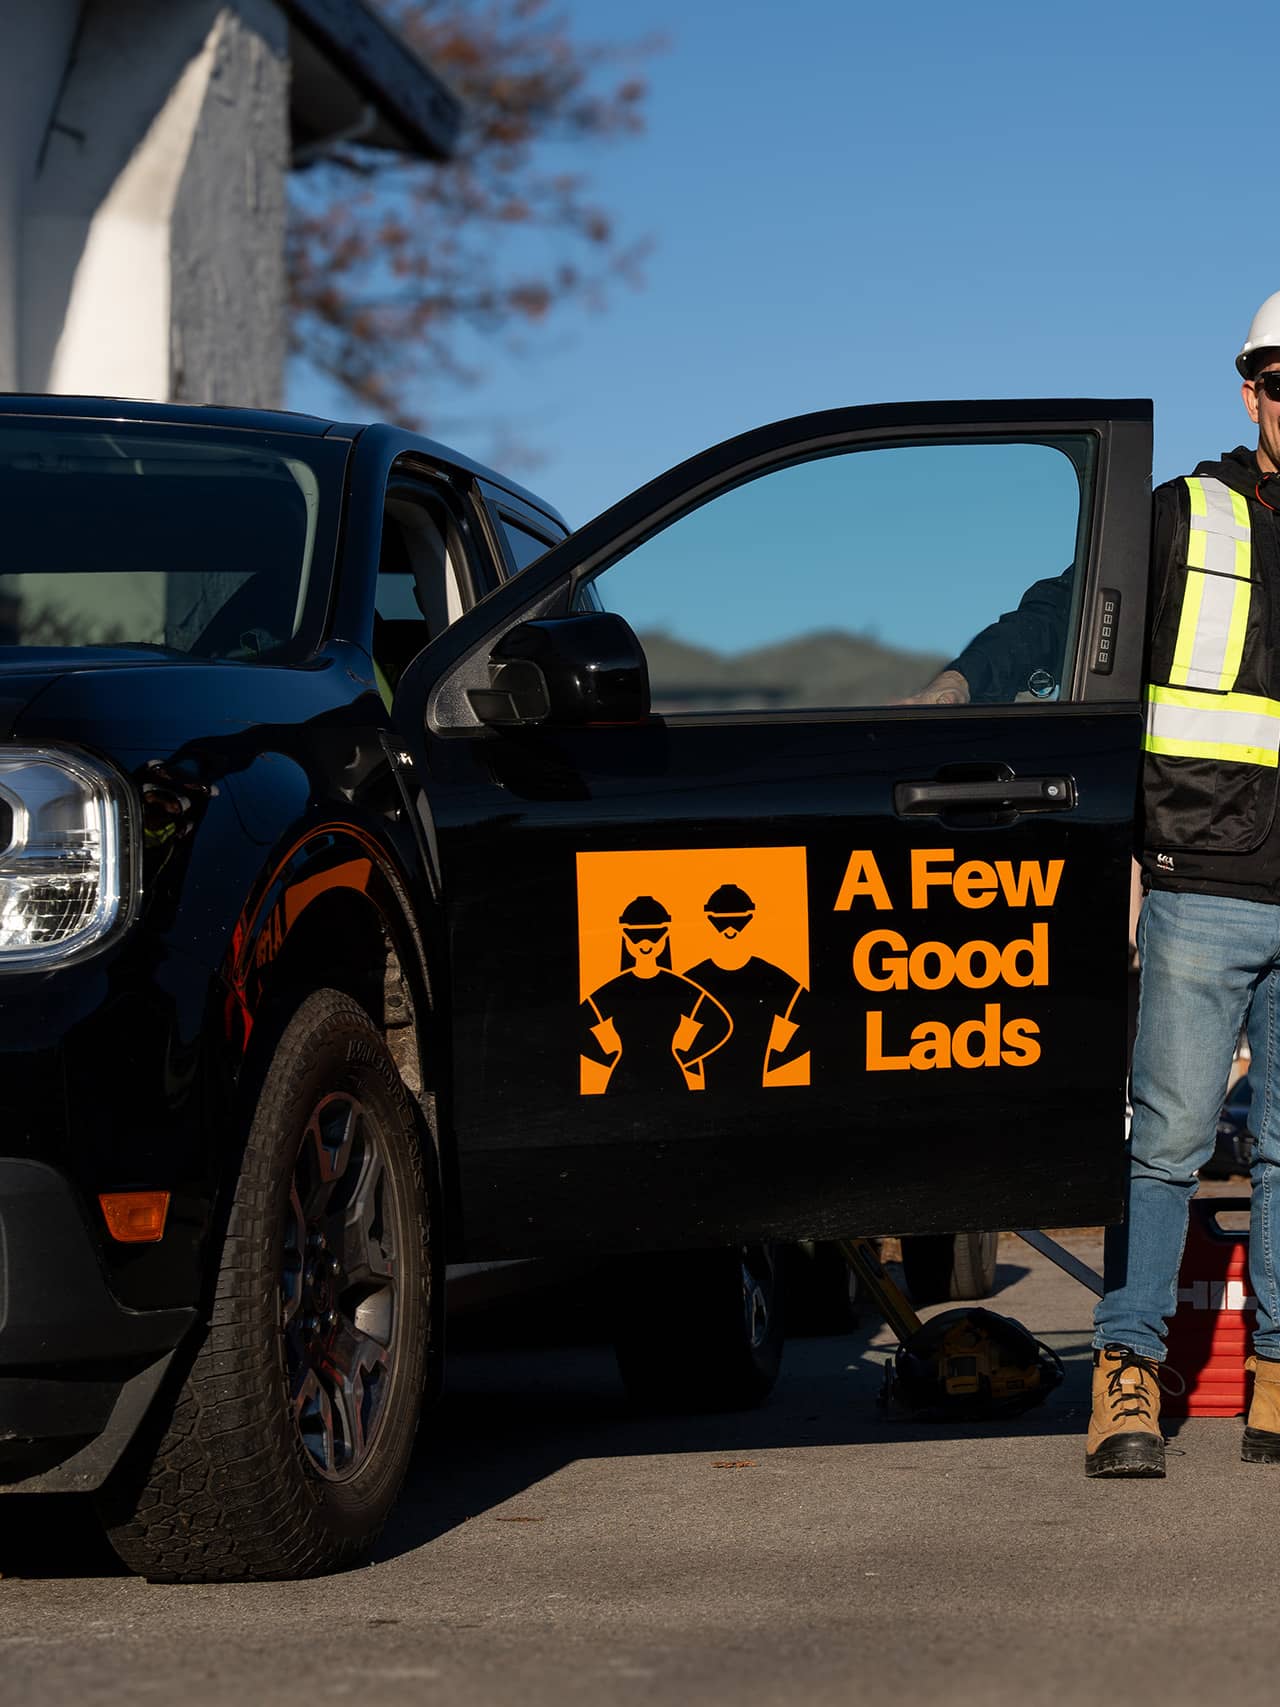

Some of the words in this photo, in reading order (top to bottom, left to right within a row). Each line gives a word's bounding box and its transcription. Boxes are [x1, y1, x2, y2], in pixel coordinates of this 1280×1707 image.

[834, 850, 893, 911] A
[911, 848, 1065, 910] Few
[853, 922, 1049, 992] Good
[866, 1003, 1041, 1071] Lads
